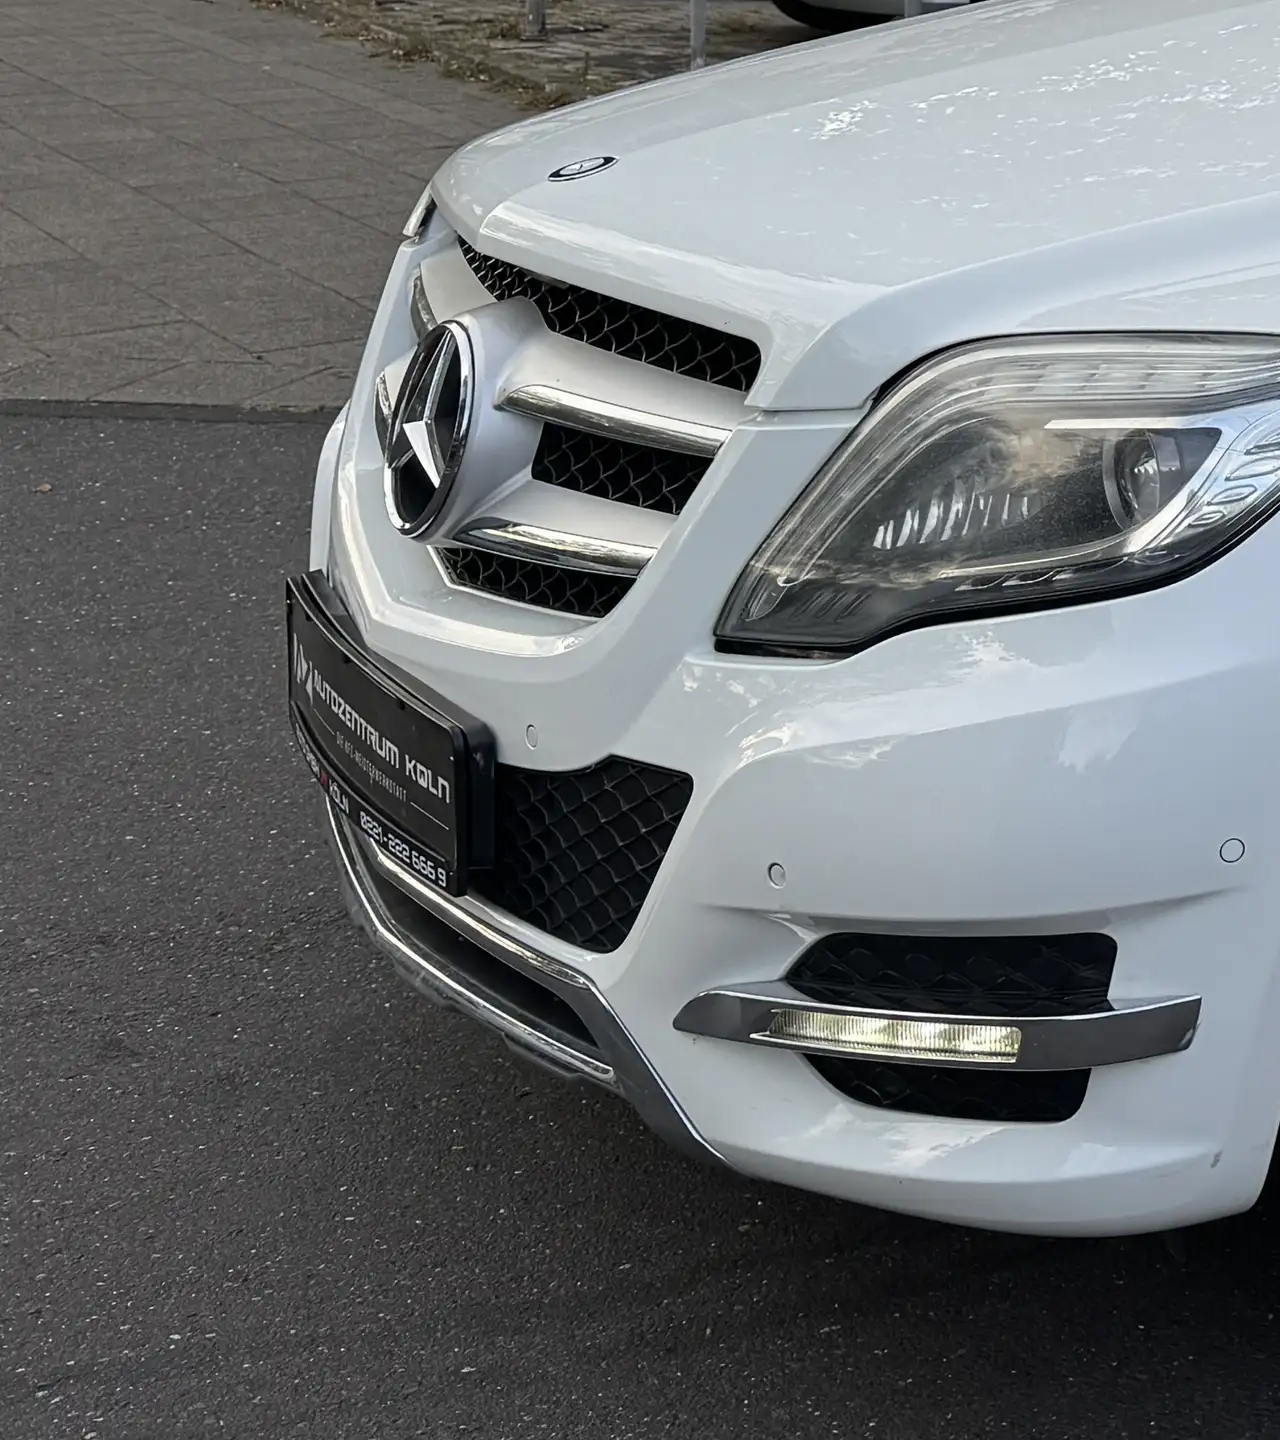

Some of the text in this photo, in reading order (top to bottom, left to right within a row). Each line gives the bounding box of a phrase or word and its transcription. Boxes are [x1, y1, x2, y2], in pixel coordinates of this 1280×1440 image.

[313, 669, 400, 769] AUTOZENTRUM
[359, 810, 447, 888] 0221-222 666 9
